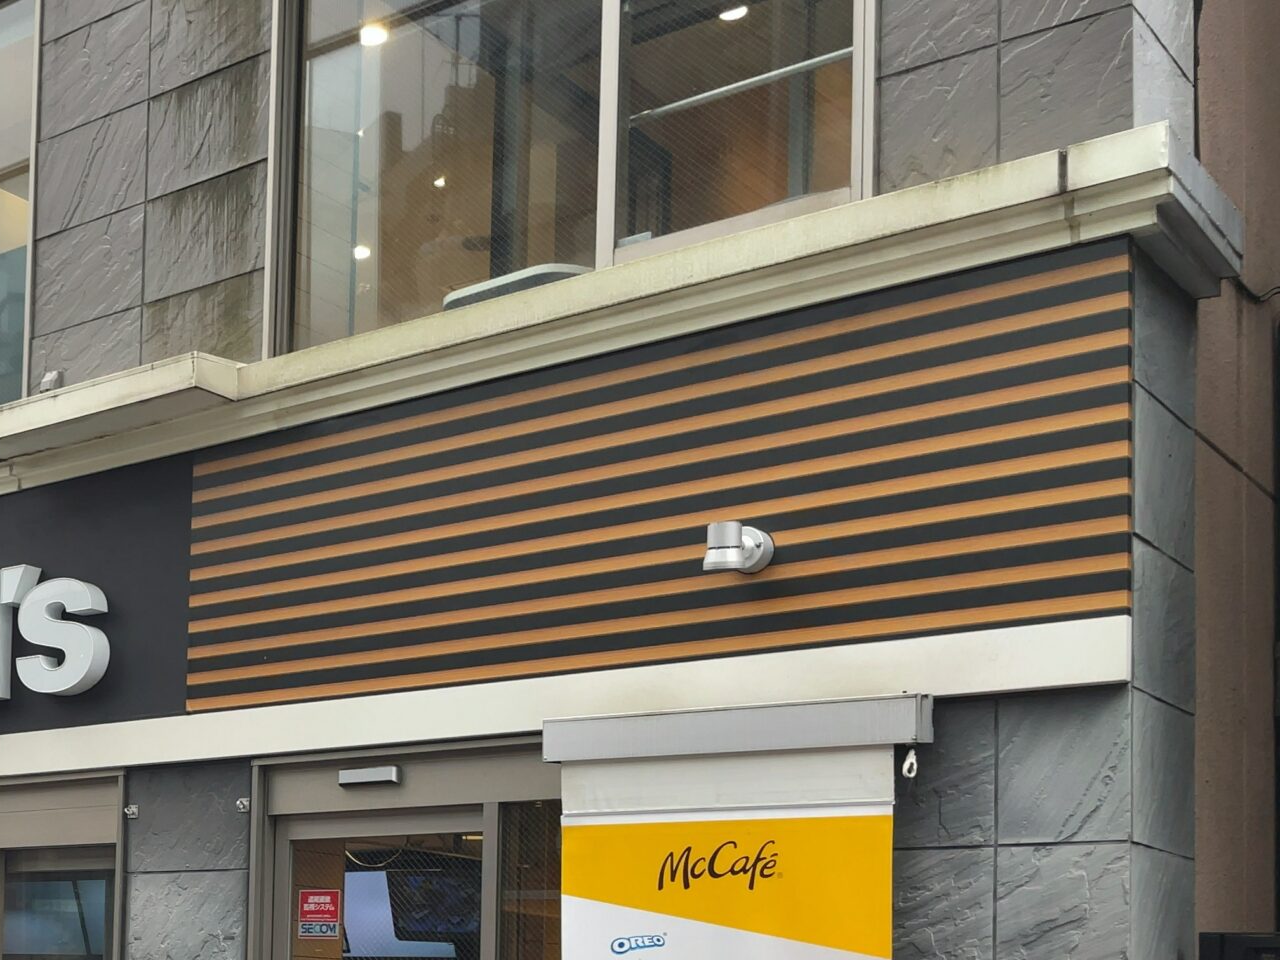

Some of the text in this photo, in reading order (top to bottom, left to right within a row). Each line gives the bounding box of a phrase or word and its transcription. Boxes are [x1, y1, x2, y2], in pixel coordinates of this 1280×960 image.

[658, 840, 779, 891] McCafé
[301, 924, 337, 934] SECOM
[611, 934, 665, 955] OREO
